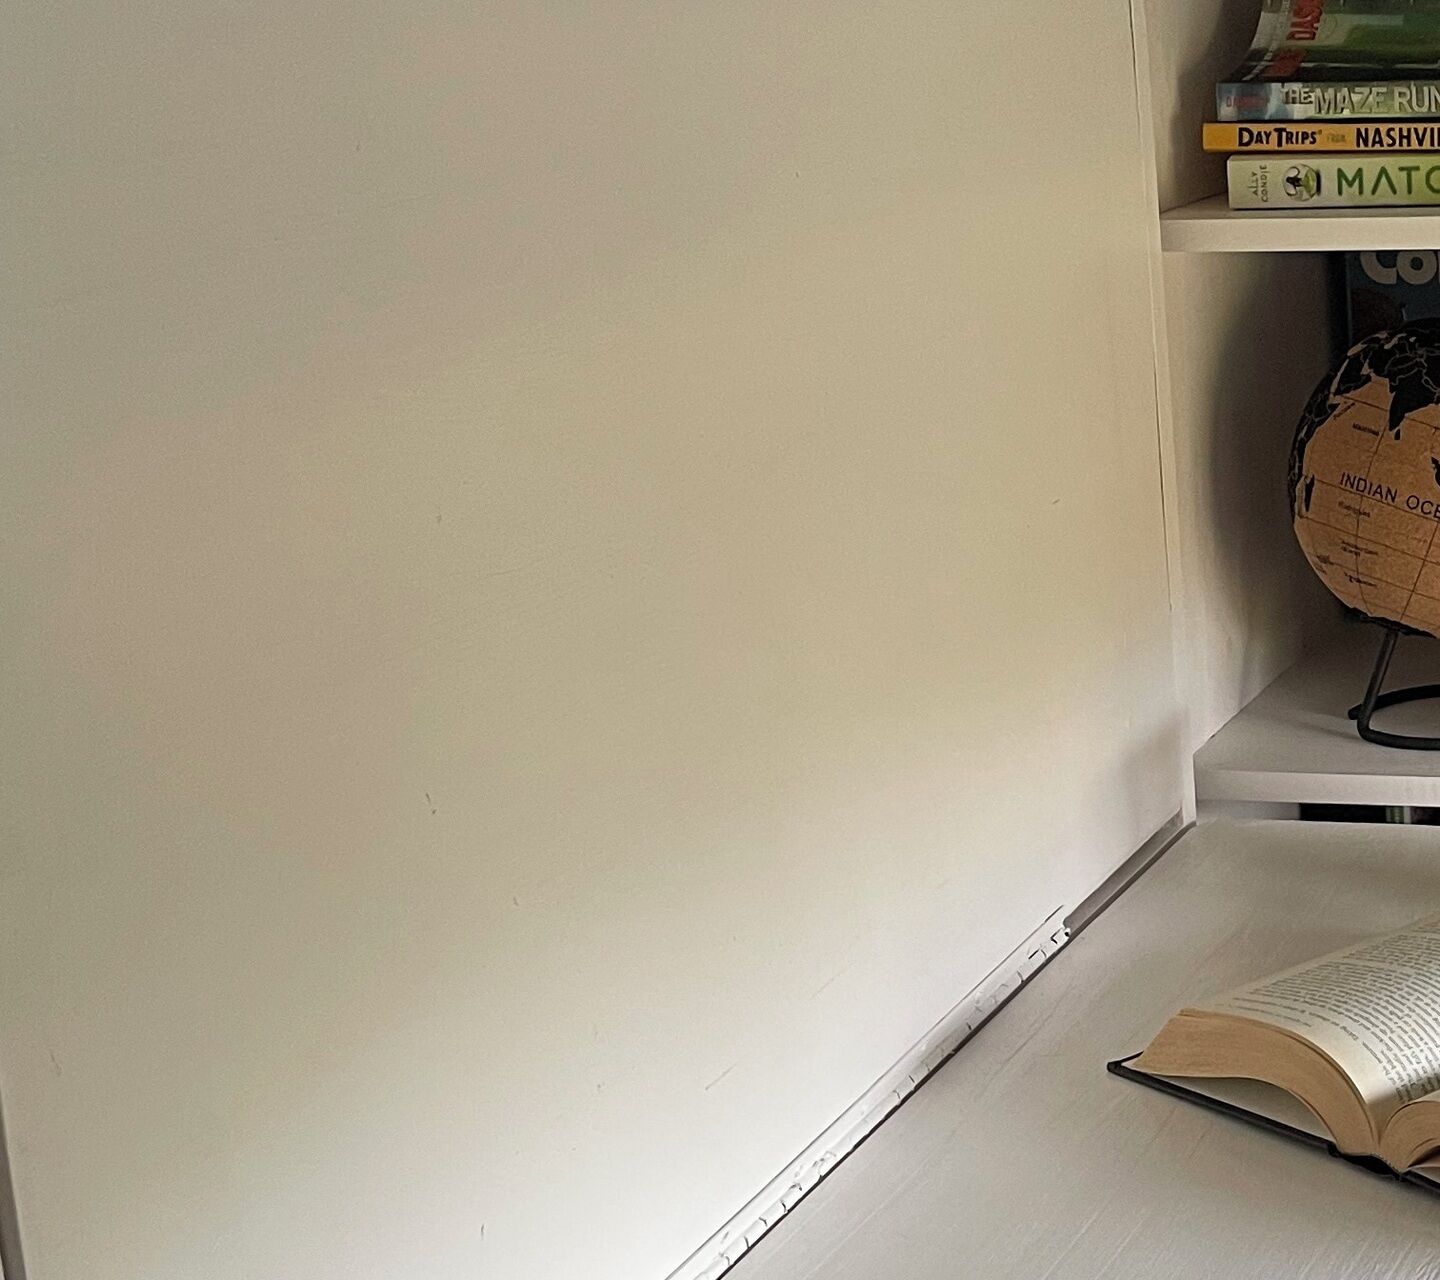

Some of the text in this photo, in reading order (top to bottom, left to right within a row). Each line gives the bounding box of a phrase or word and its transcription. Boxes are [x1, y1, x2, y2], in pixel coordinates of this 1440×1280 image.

[1280, 83, 1315, 105] THE
[1313, 86, 1388, 115] MAZE
[1247, 170, 1259, 197] ALLY
[1259, 164, 1271, 203] CONDIE
[1340, 472, 1398, 503] INDIAN
